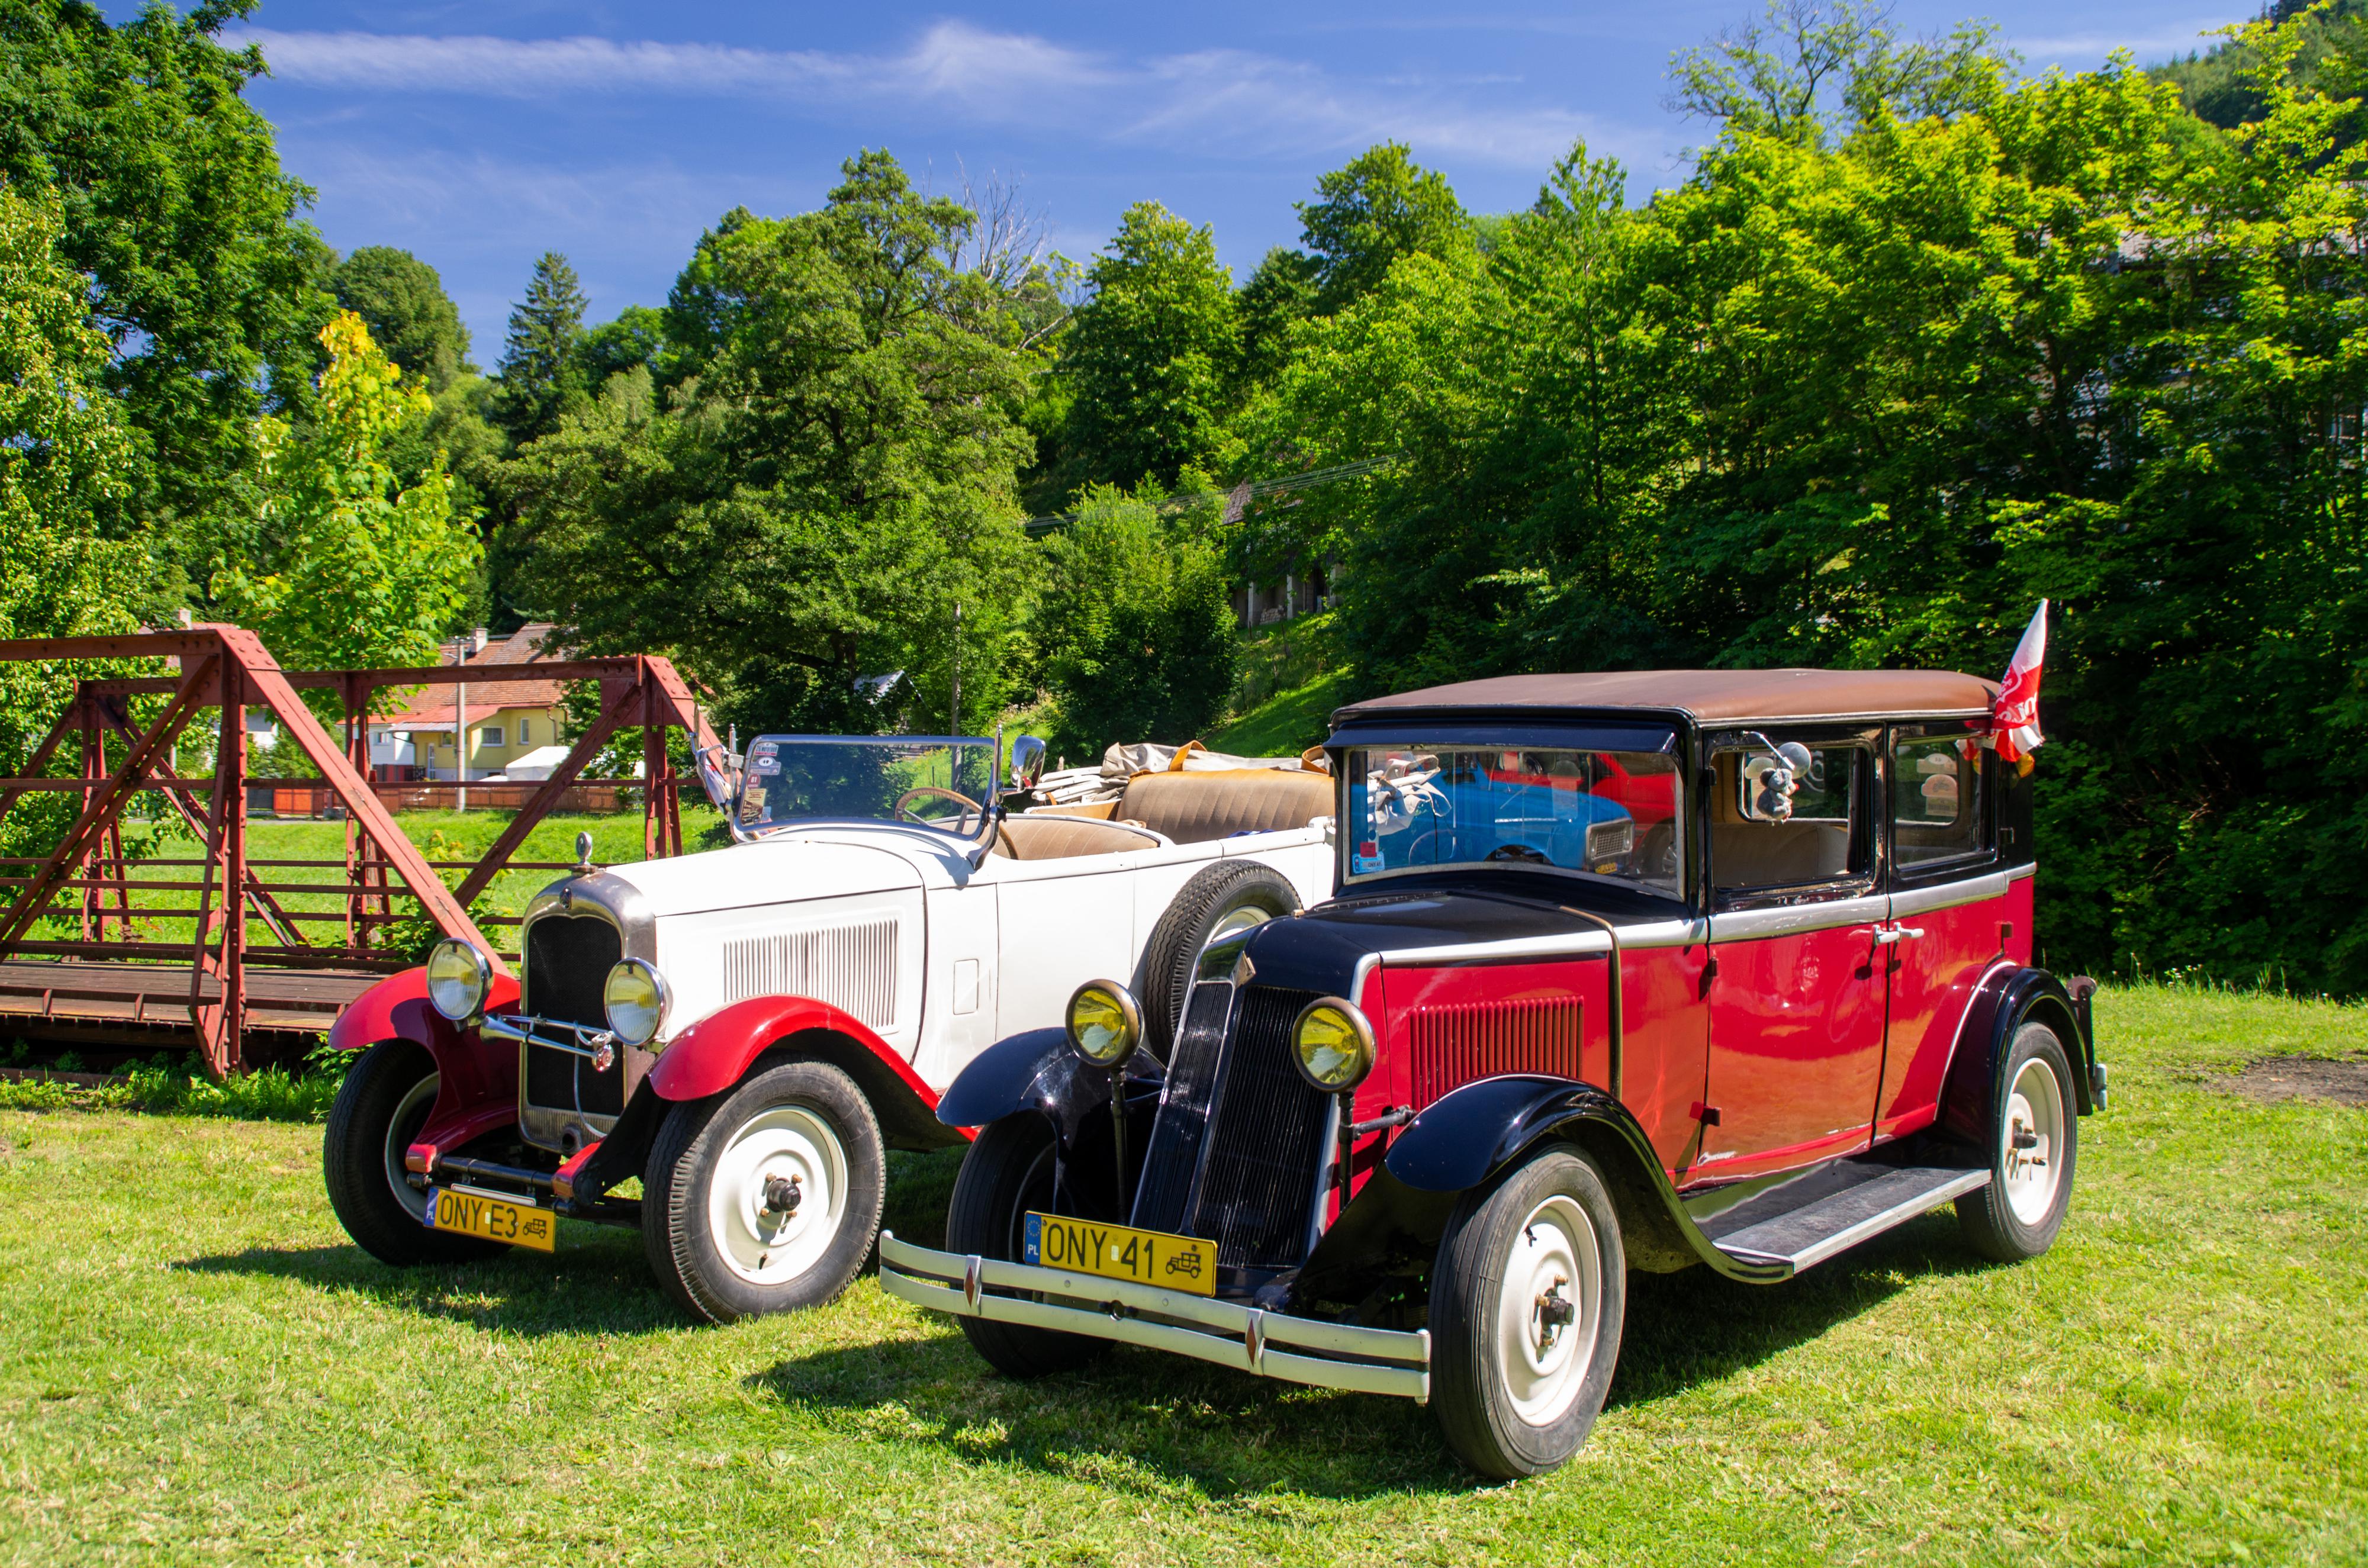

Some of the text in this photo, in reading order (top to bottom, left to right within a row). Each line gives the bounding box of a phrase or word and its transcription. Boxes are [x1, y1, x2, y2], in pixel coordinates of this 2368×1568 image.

[426, 1210, 435, 1220] PL
[440, 1194, 518, 1238] ONY E3
[1028, 1244, 1039, 1256] PL
[1047, 1224, 1154, 1279] ONY 41
